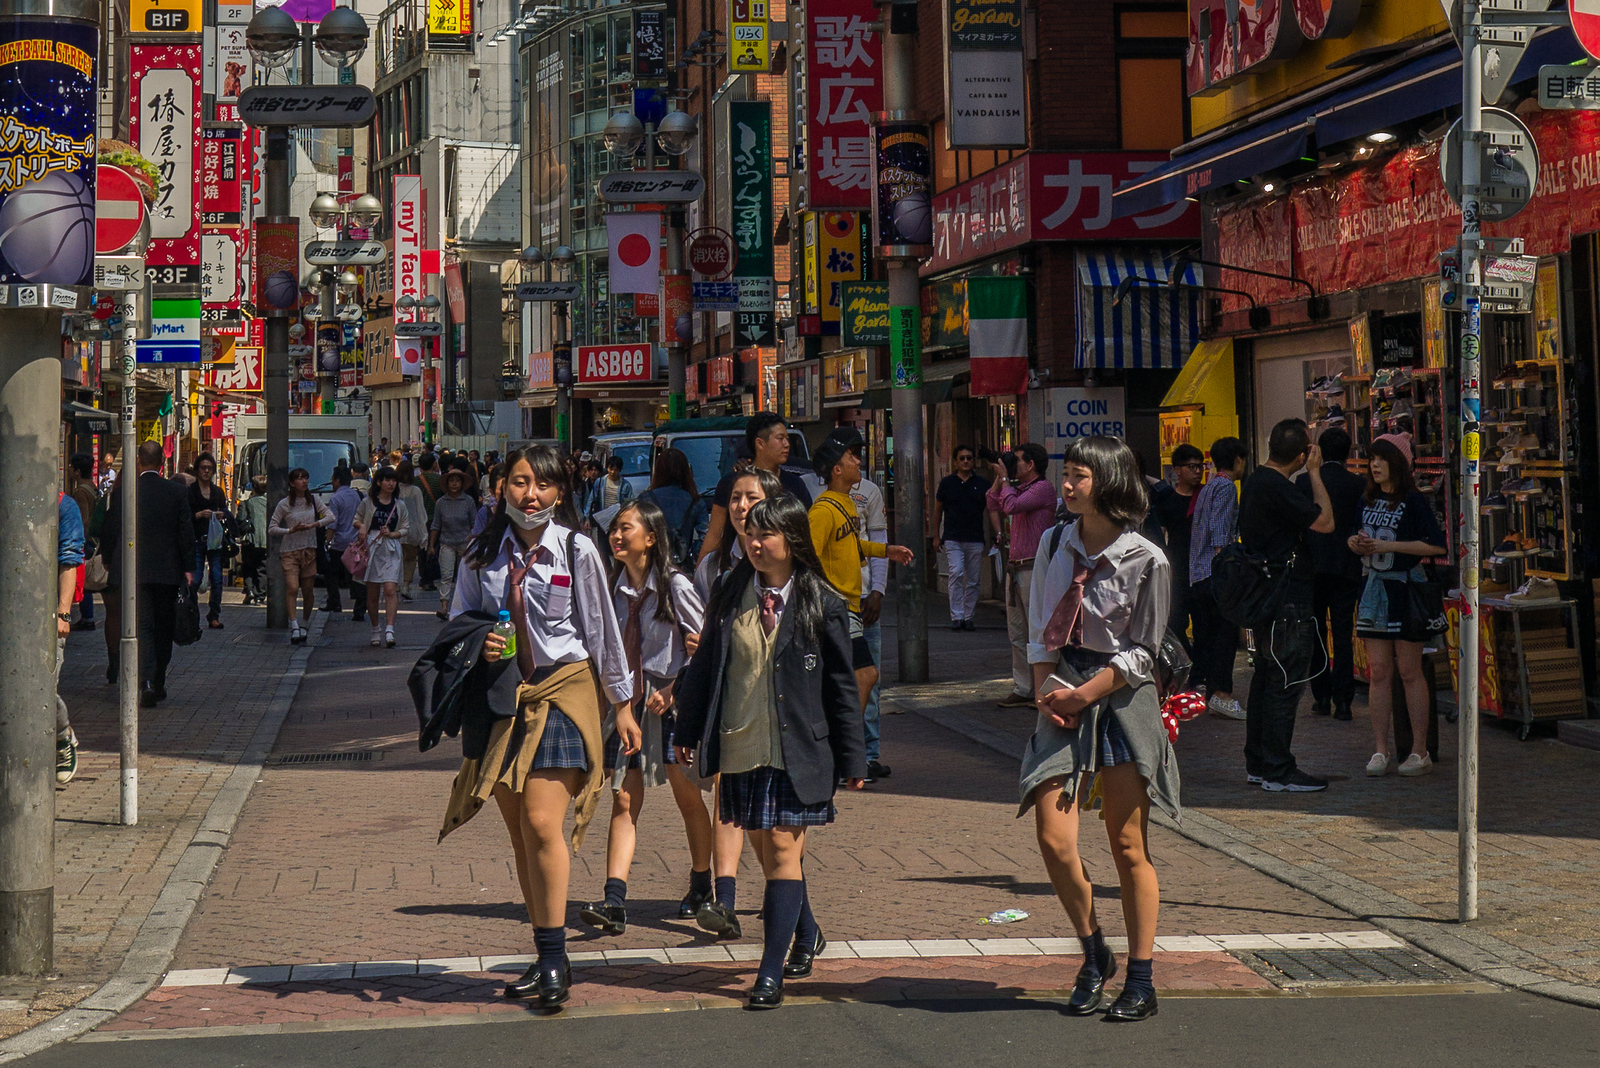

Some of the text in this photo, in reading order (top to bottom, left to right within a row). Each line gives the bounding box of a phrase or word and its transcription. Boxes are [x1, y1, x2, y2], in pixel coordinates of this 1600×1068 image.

[152, 13, 182, 27] B1F
[228, 9, 242, 18] 2F
[738, 28, 760, 39] りらく
[958, 33, 1017, 41] マイアミガーデン
[1547, 75, 1600, 100] 自転車
[246, 96, 369, 112] 渋谷センター街
[814, 14, 874, 190] 歌広場
[957, 109, 1020, 117] VANDALISM
[0, 117, 95, 158] ケットボール
[148, 88, 186, 218] 椿屋カフェ
[223, 144, 234, 179] 江戸前
[204, 141, 219, 199] お好み焼
[1536, 159, 1566, 197] SALE
[606, 179, 699, 193] 渋谷センター街
[931, 162, 1025, 262] オケ歌広場
[1339, 213, 1360, 243] SALE
[1362, 206, 1384, 236] SALE
[1386, 198, 1410, 231] SALE
[1413, 192, 1438, 224] SALE
[397, 201, 418, 247] myT
[310, 247, 381, 257] 渋谷センター街
[694, 247, 727, 263] 消火栓
[216, 239, 225, 285] ケーキと
[202, 262, 212, 298] お食事
[520, 286, 576, 295] 渋谷センター街
[848, 297, 890, 314] Miam
[202, 310, 228, 320] 2・3F
[740, 313, 767, 324] B1F
[854, 334, 890, 343] マイアミガー
[153, 351, 163, 361] 酒
[585, 350, 643, 378] ASBee
[1067, 400, 1108, 416] COIN
[1057, 421, 1124, 438] LOCKER
[1362, 510, 1401, 529] MOUSE
